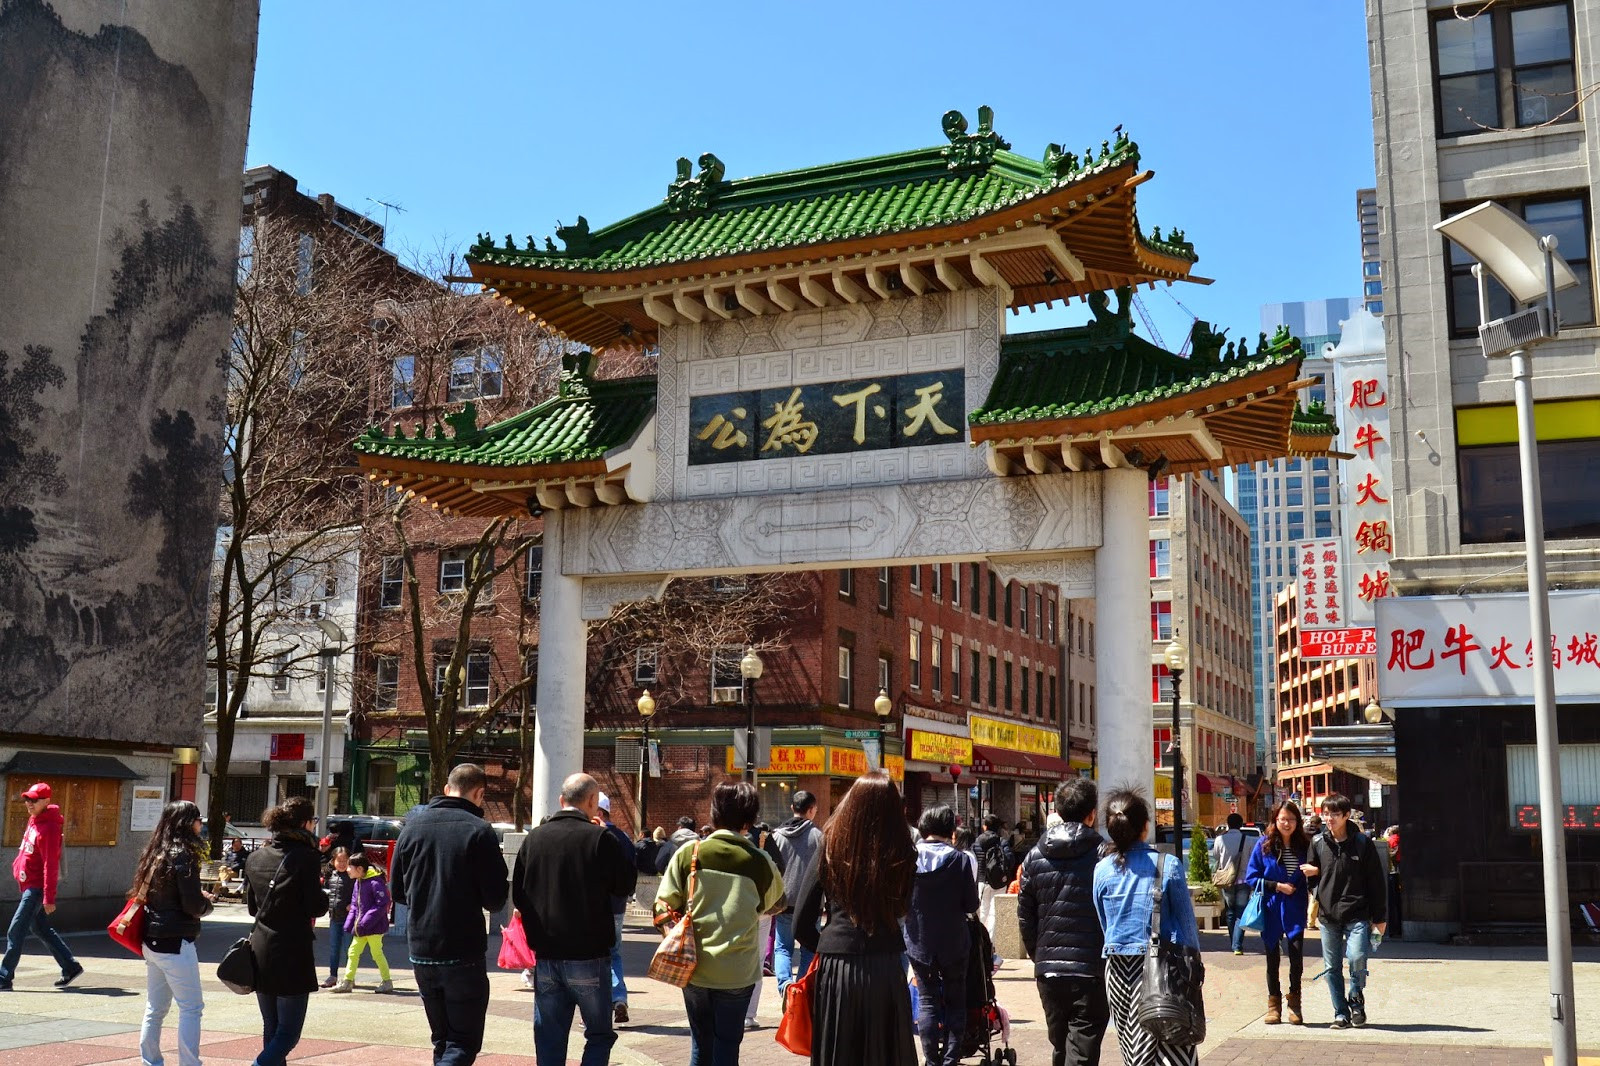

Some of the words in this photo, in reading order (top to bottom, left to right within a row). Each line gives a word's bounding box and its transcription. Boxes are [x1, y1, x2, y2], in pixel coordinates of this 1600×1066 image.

[1309, 631, 1349, 644] HOT
[1360, 629, 1376, 642] P
[852, 730, 870, 738] HUDSON
